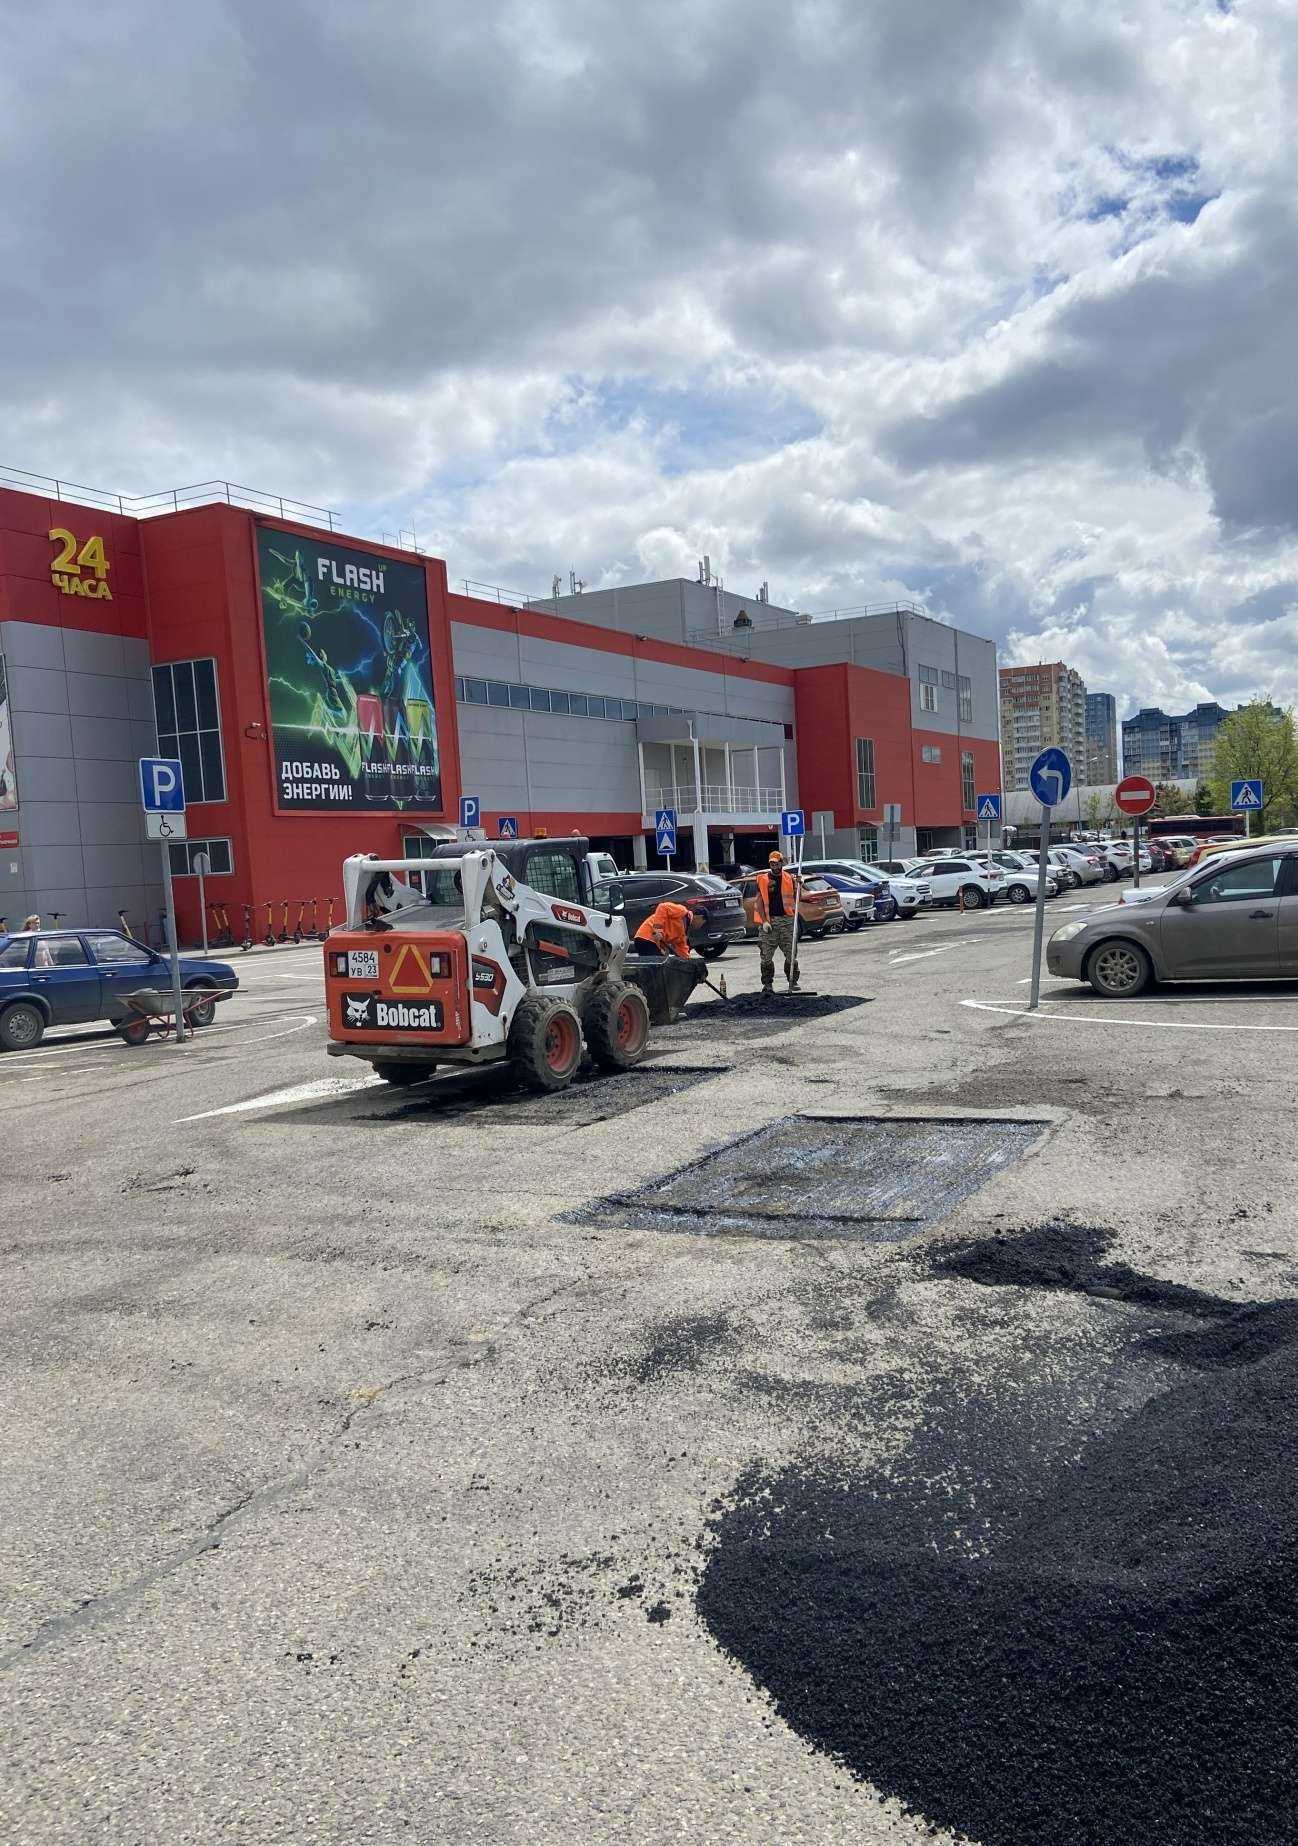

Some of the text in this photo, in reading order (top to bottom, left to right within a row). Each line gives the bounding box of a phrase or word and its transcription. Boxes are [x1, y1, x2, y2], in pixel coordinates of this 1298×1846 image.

[48, 528, 110, 578] 24
[317, 557, 384, 594] FLASH
[52, 573, 113, 600] ЧАСА
[329, 585, 375, 604] ENERGY
[282, 762, 340, 780] ДОБАВЬ
[361, 762, 387, 773] FLASH
[152, 765, 177, 806] P
[283, 783, 353, 800] ЭНЕРГИИ!
[464, 800, 476, 825] P
[787, 813, 800, 834] P
[352, 952, 375, 963] 4584
[367, 965, 377, 974] 23
[376, 1003, 437, 1027] Bobcat
